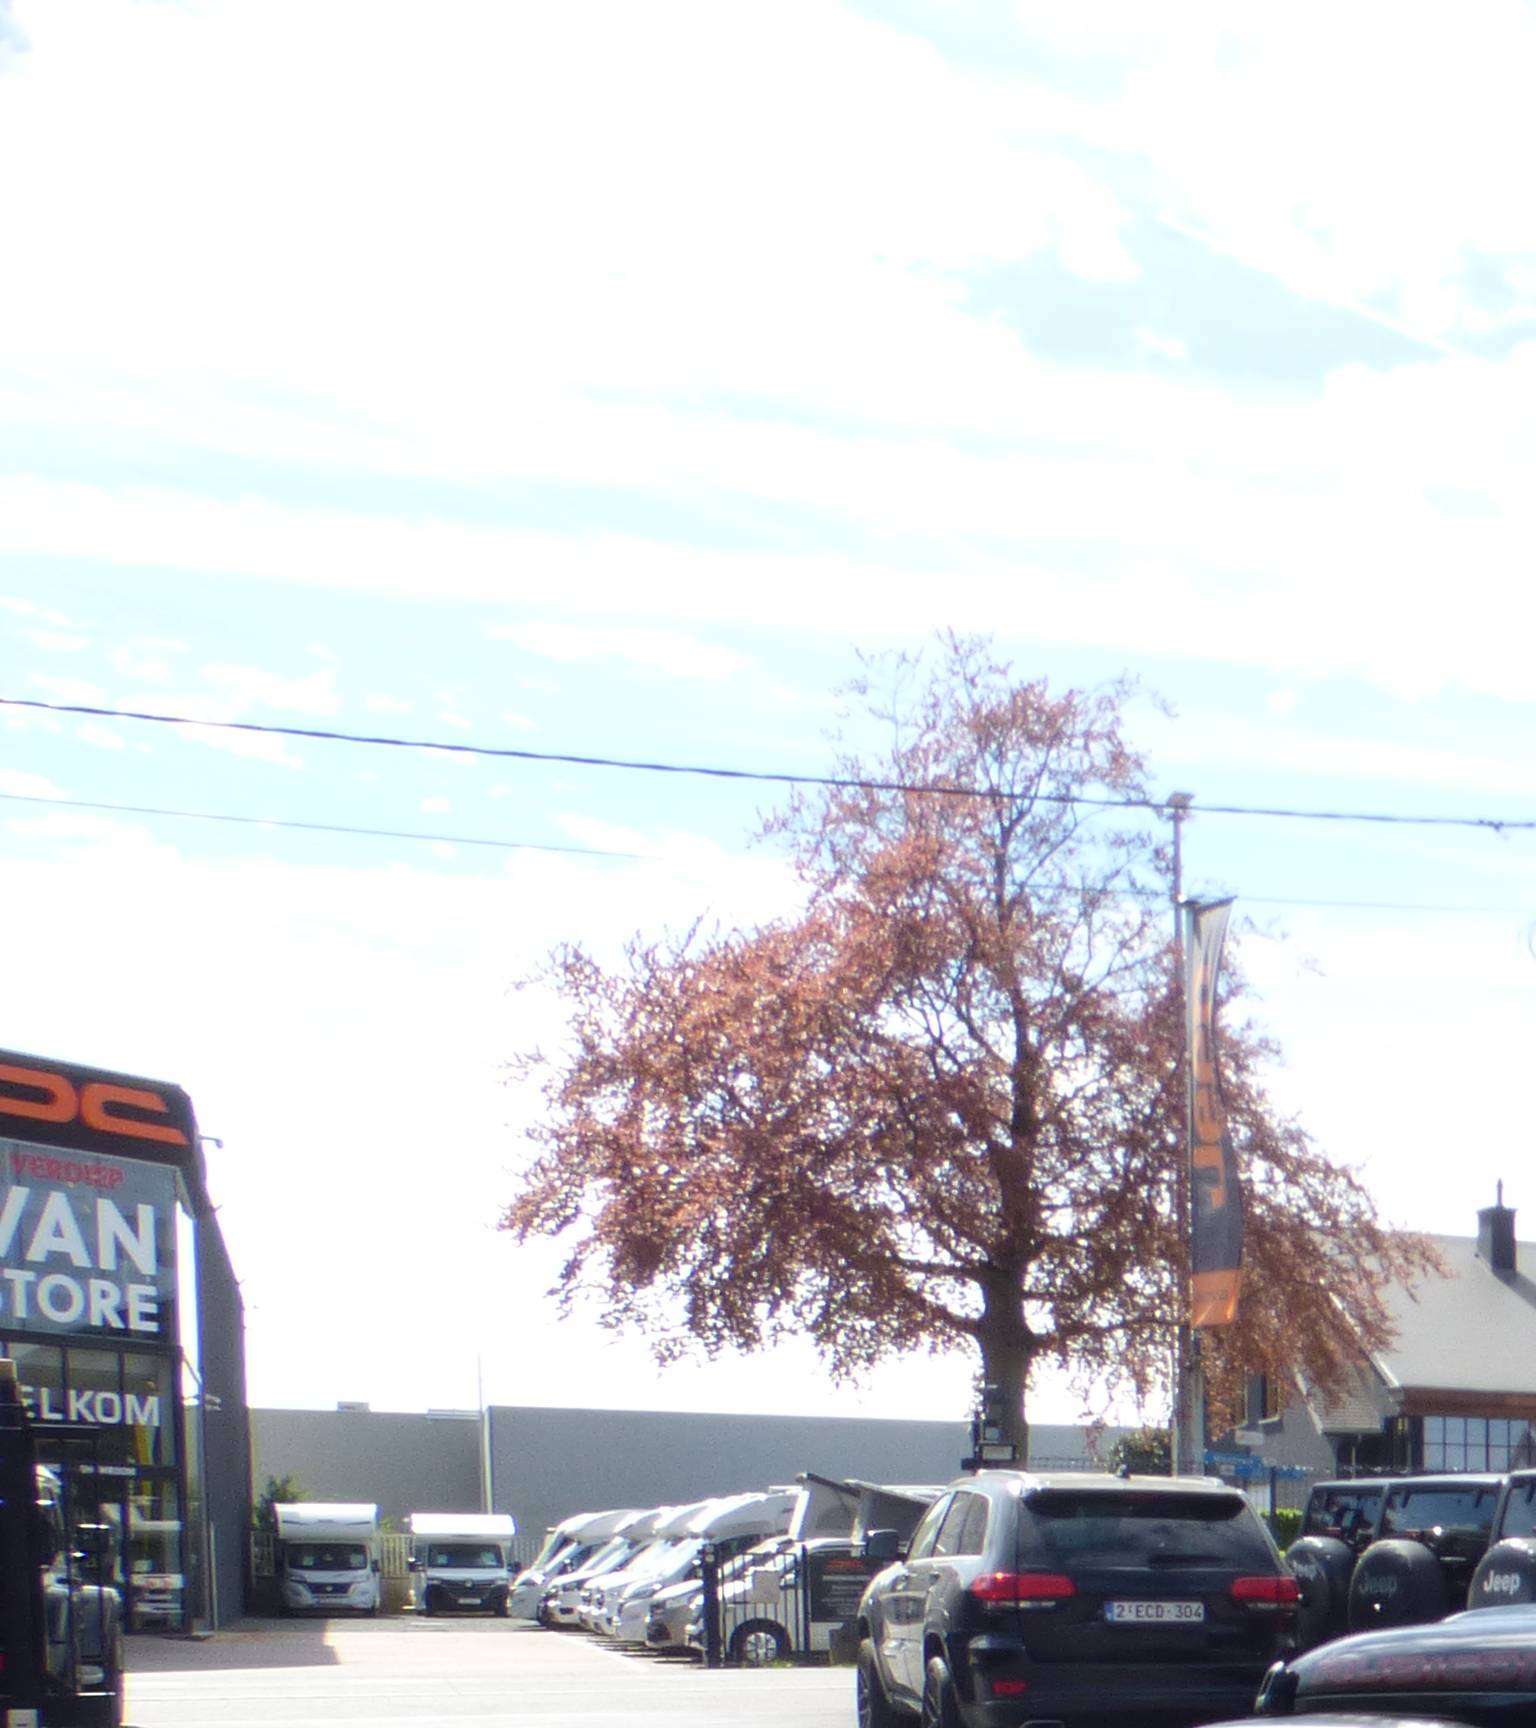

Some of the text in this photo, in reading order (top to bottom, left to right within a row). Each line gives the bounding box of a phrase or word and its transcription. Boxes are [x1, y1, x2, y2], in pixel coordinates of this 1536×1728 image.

[0, 1268, 159, 1332] TORE
[20, 1384, 160, 1427] ELKOM
[1483, 1569, 1521, 1595] Jeep
